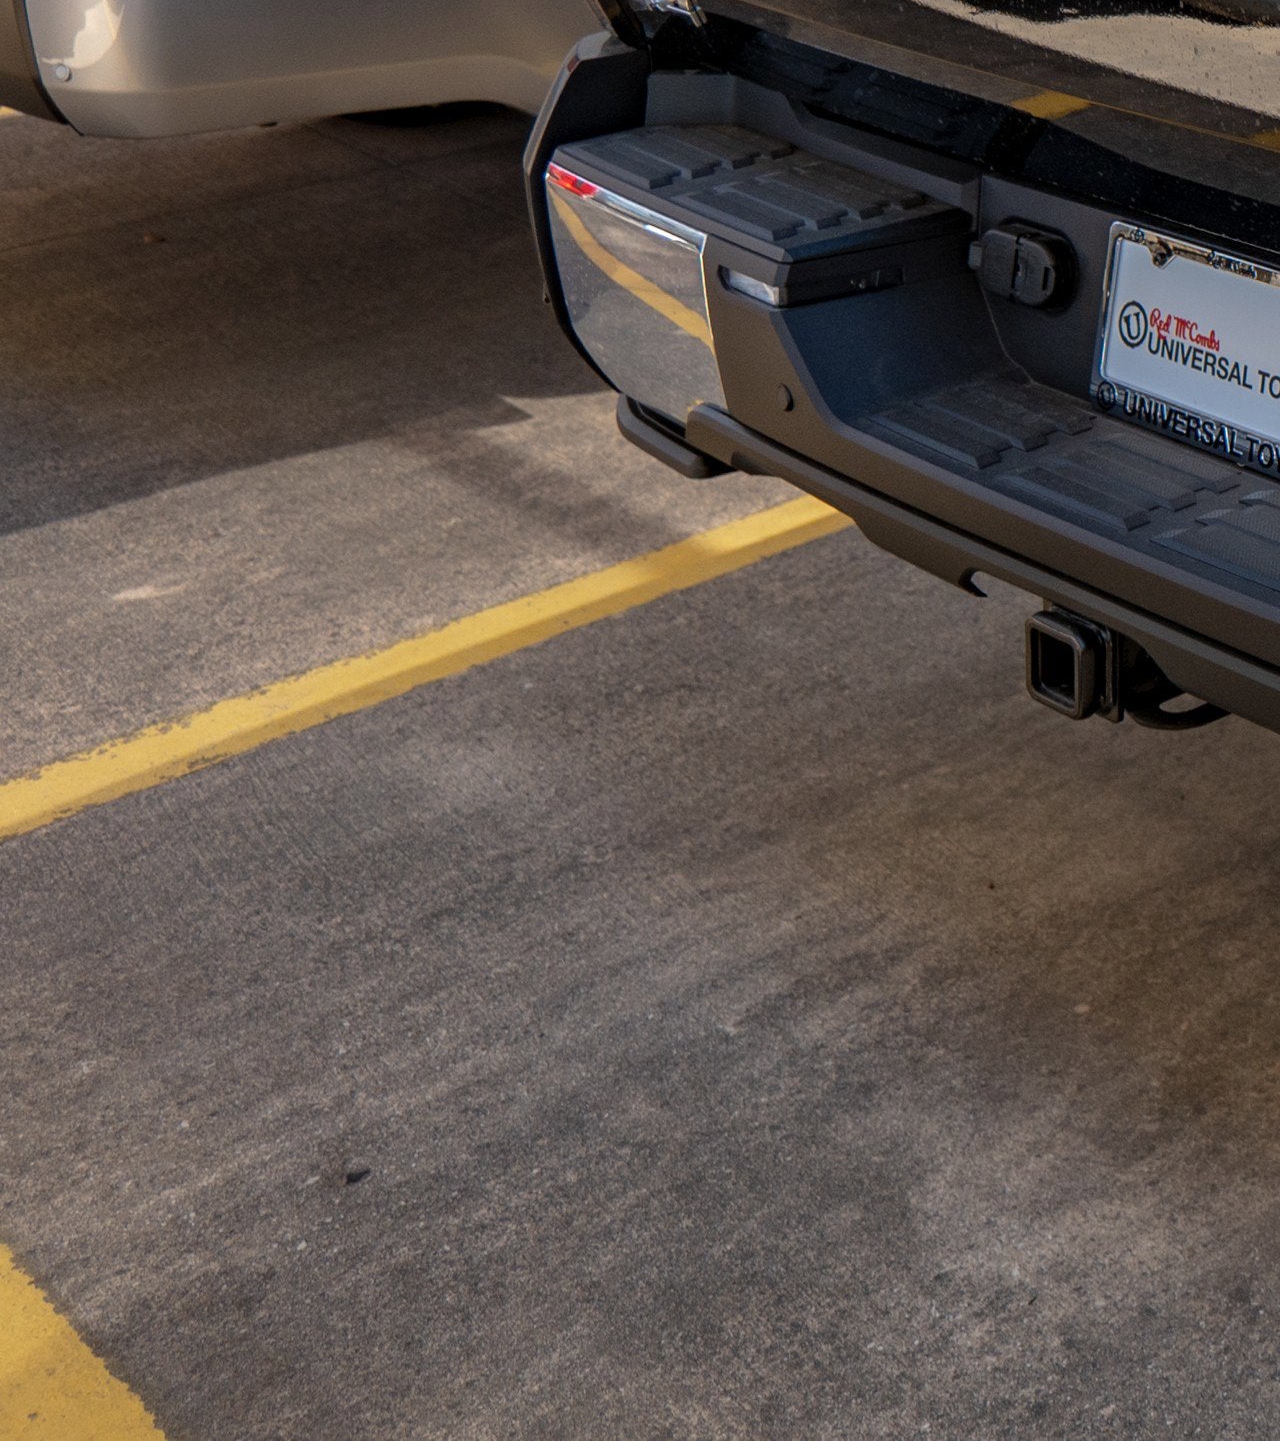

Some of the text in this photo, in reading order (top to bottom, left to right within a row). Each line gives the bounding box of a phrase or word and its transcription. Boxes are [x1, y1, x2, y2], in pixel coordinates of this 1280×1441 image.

[1149, 308, 1221, 352] Red McCombs
[1148, 331, 1253, 391] UNIVERSAL
[1123, 388, 1244, 458] UNIVERSAL
